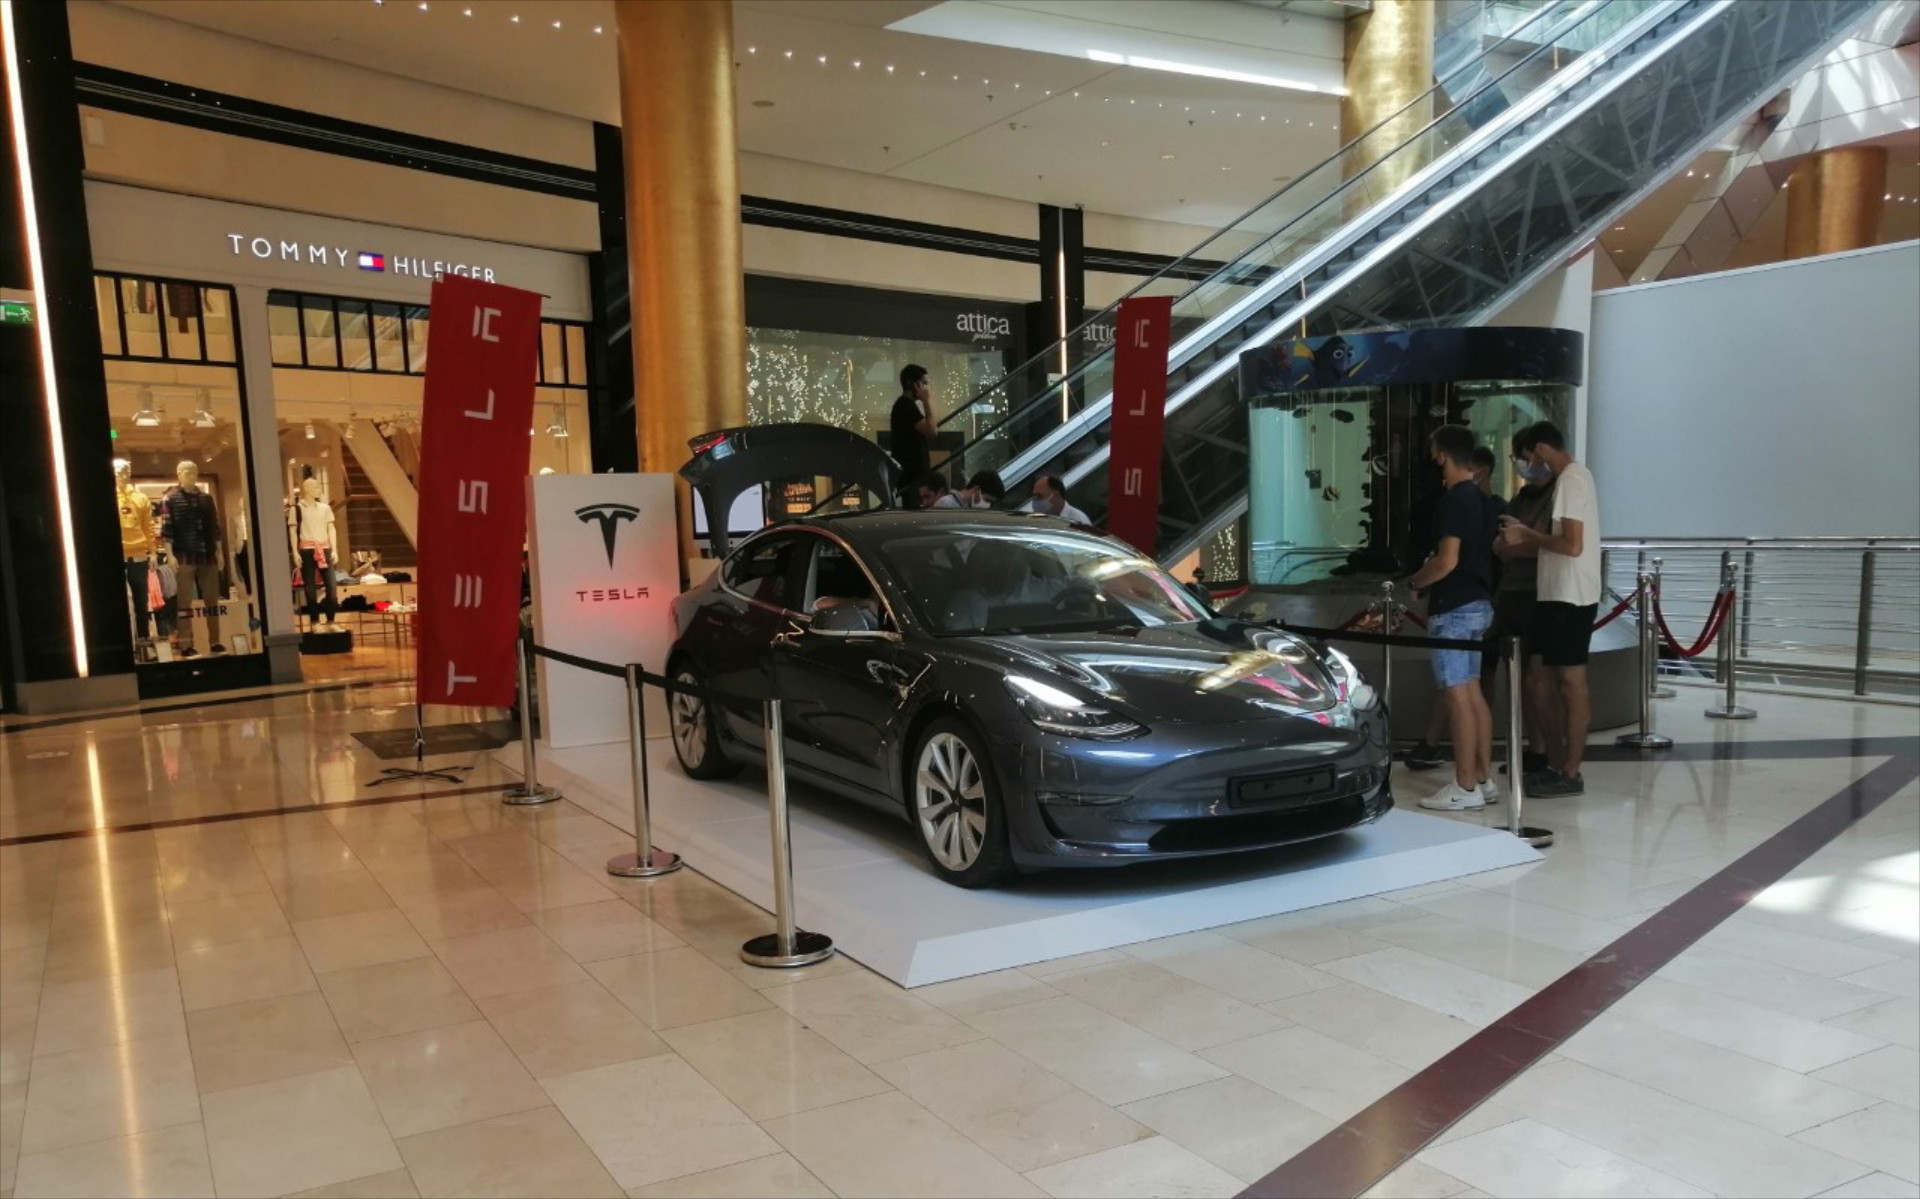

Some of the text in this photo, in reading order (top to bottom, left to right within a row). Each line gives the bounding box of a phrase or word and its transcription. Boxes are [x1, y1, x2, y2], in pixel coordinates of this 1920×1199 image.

[228, 234, 348, 267] TOMMY
[956, 312, 1010, 335] attica
[1083, 323, 1117, 341] attic
[1125, 318, 1150, 497] SLA
[447, 305, 501, 696] TESLA
[576, 587, 649, 602] TESLA
